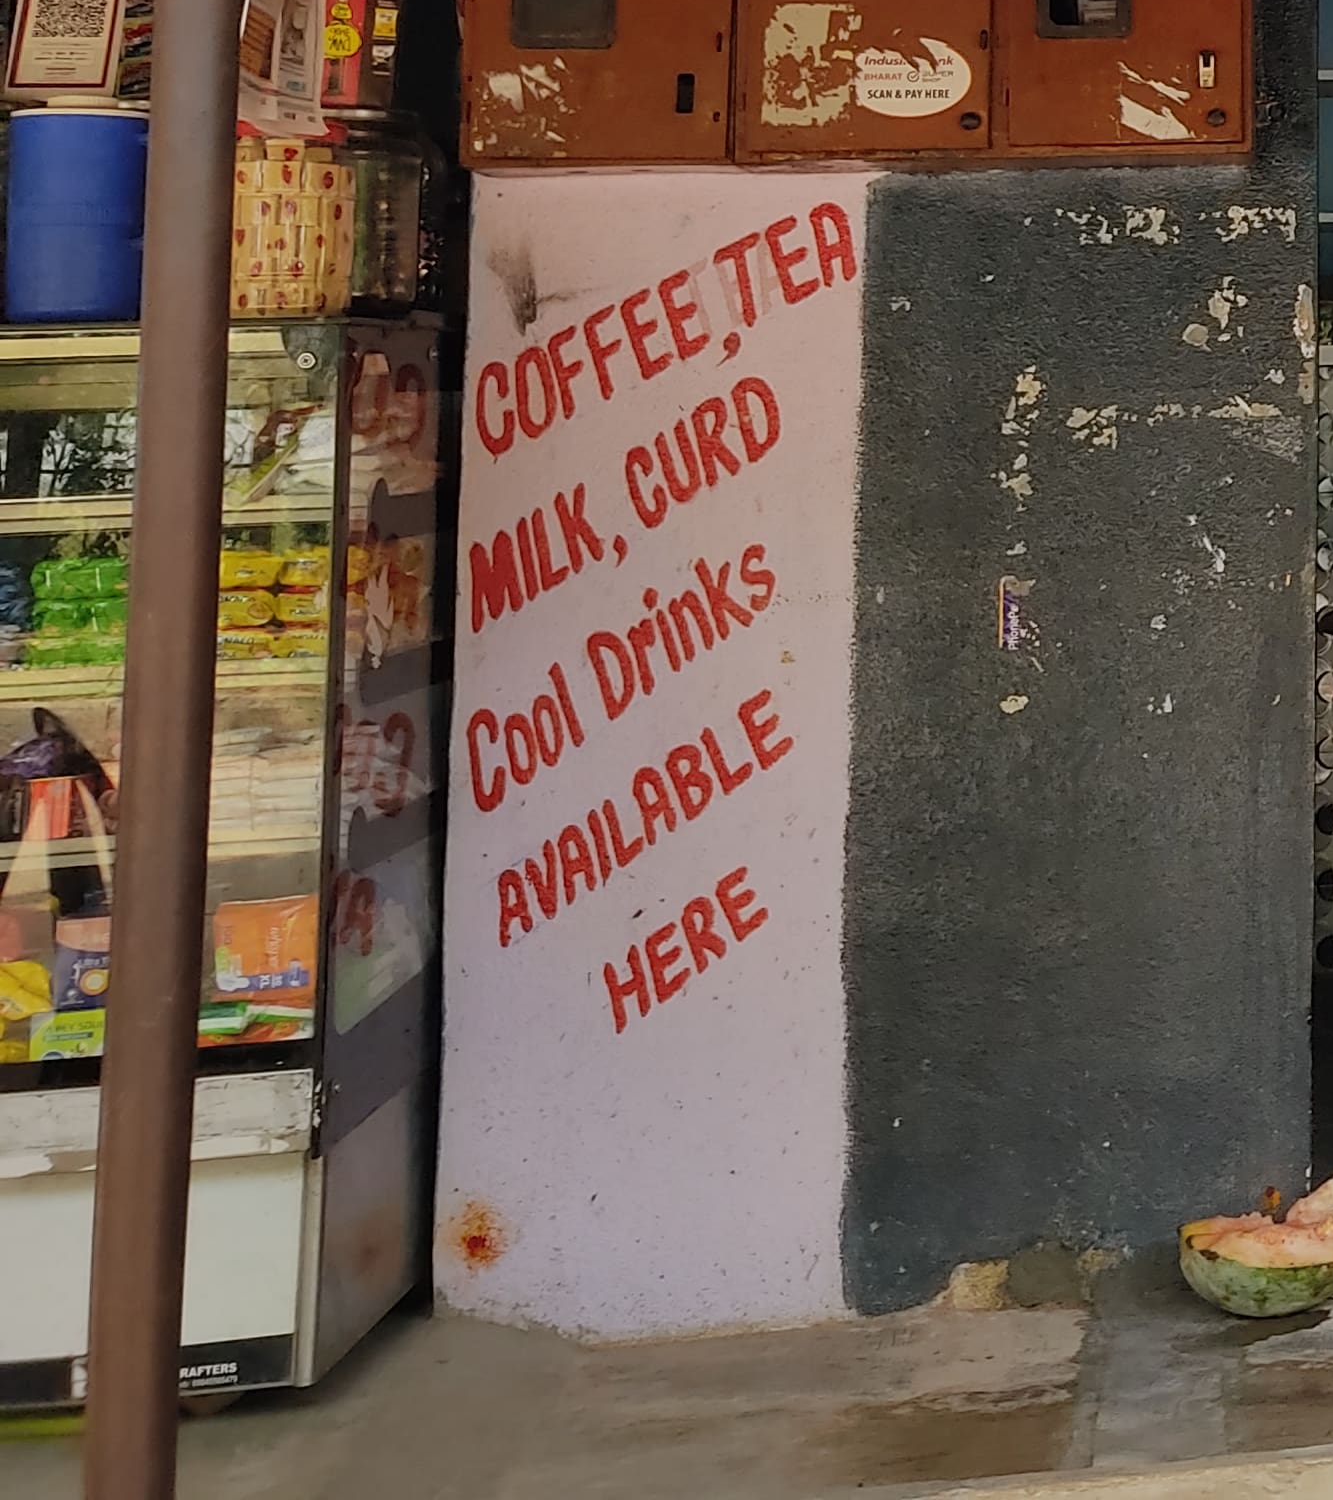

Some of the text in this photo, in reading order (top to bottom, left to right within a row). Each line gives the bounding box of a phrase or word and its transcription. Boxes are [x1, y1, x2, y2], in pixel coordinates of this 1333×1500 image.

[867, 89, 951, 99] SCAN & PAY HERE
[713, 202, 857, 328] TEA
[468, 376, 781, 635] MILK, CURD
[466, 543, 776, 813] Cool Drinks
[496, 689, 795, 948] AVAILABLE
[603, 865, 769, 1034] HERE
[179, 1362, 238, 1379] RAFTERS
